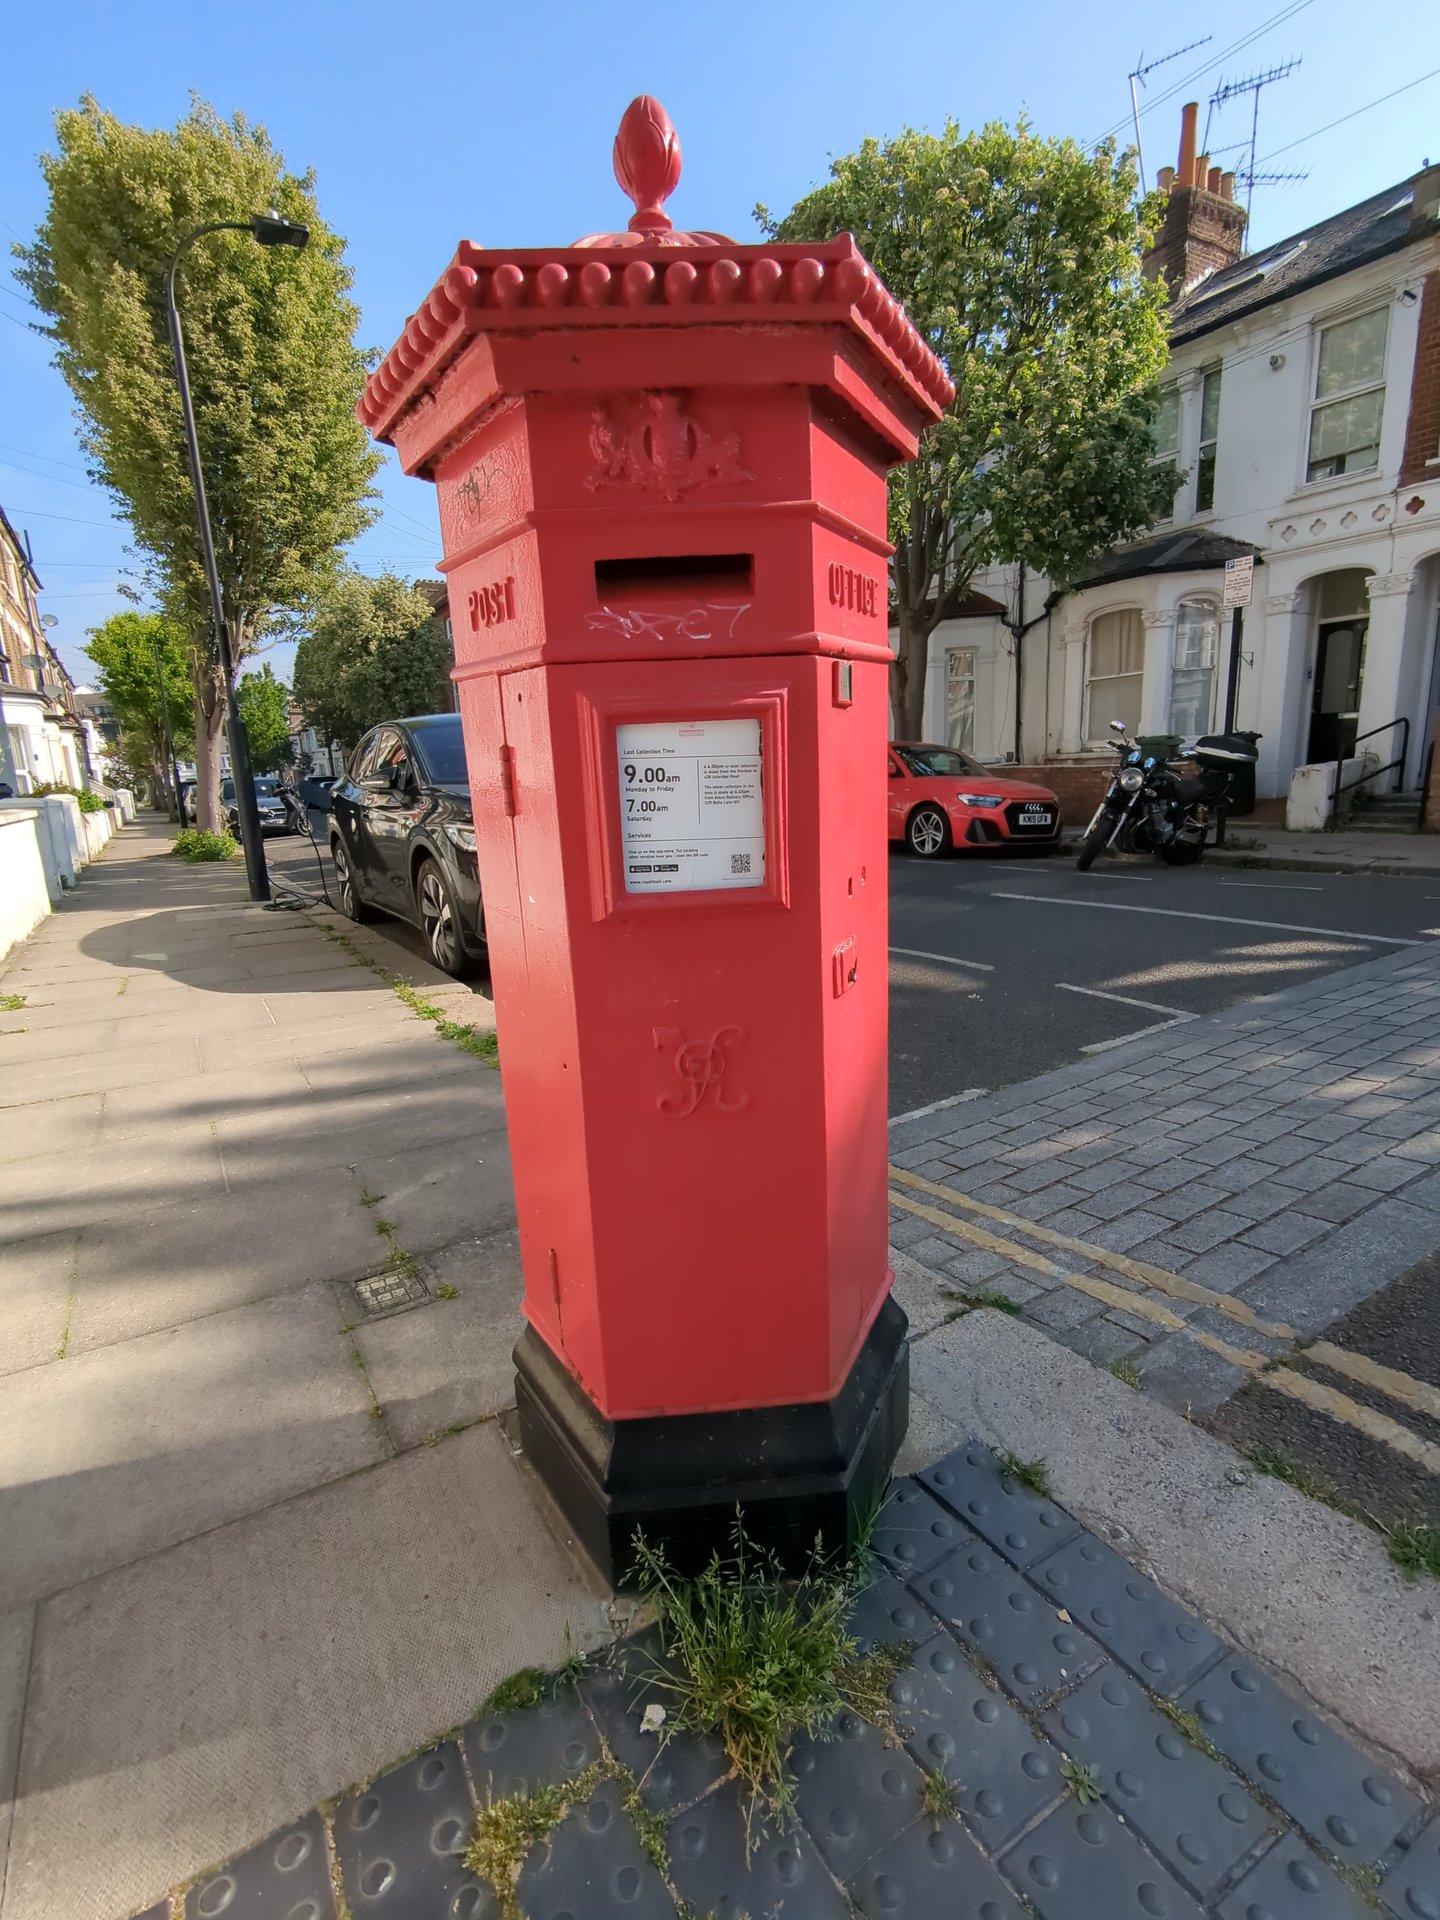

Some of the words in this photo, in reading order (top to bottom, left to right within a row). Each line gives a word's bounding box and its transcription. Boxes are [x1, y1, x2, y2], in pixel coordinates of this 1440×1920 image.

[829, 562, 878, 618] OFFICE
[468, 576, 516, 632] POST
[624, 764, 681, 784] 9.00am
[657, 785, 675, 793] Friday
[626, 799, 668, 812] 7.00am
